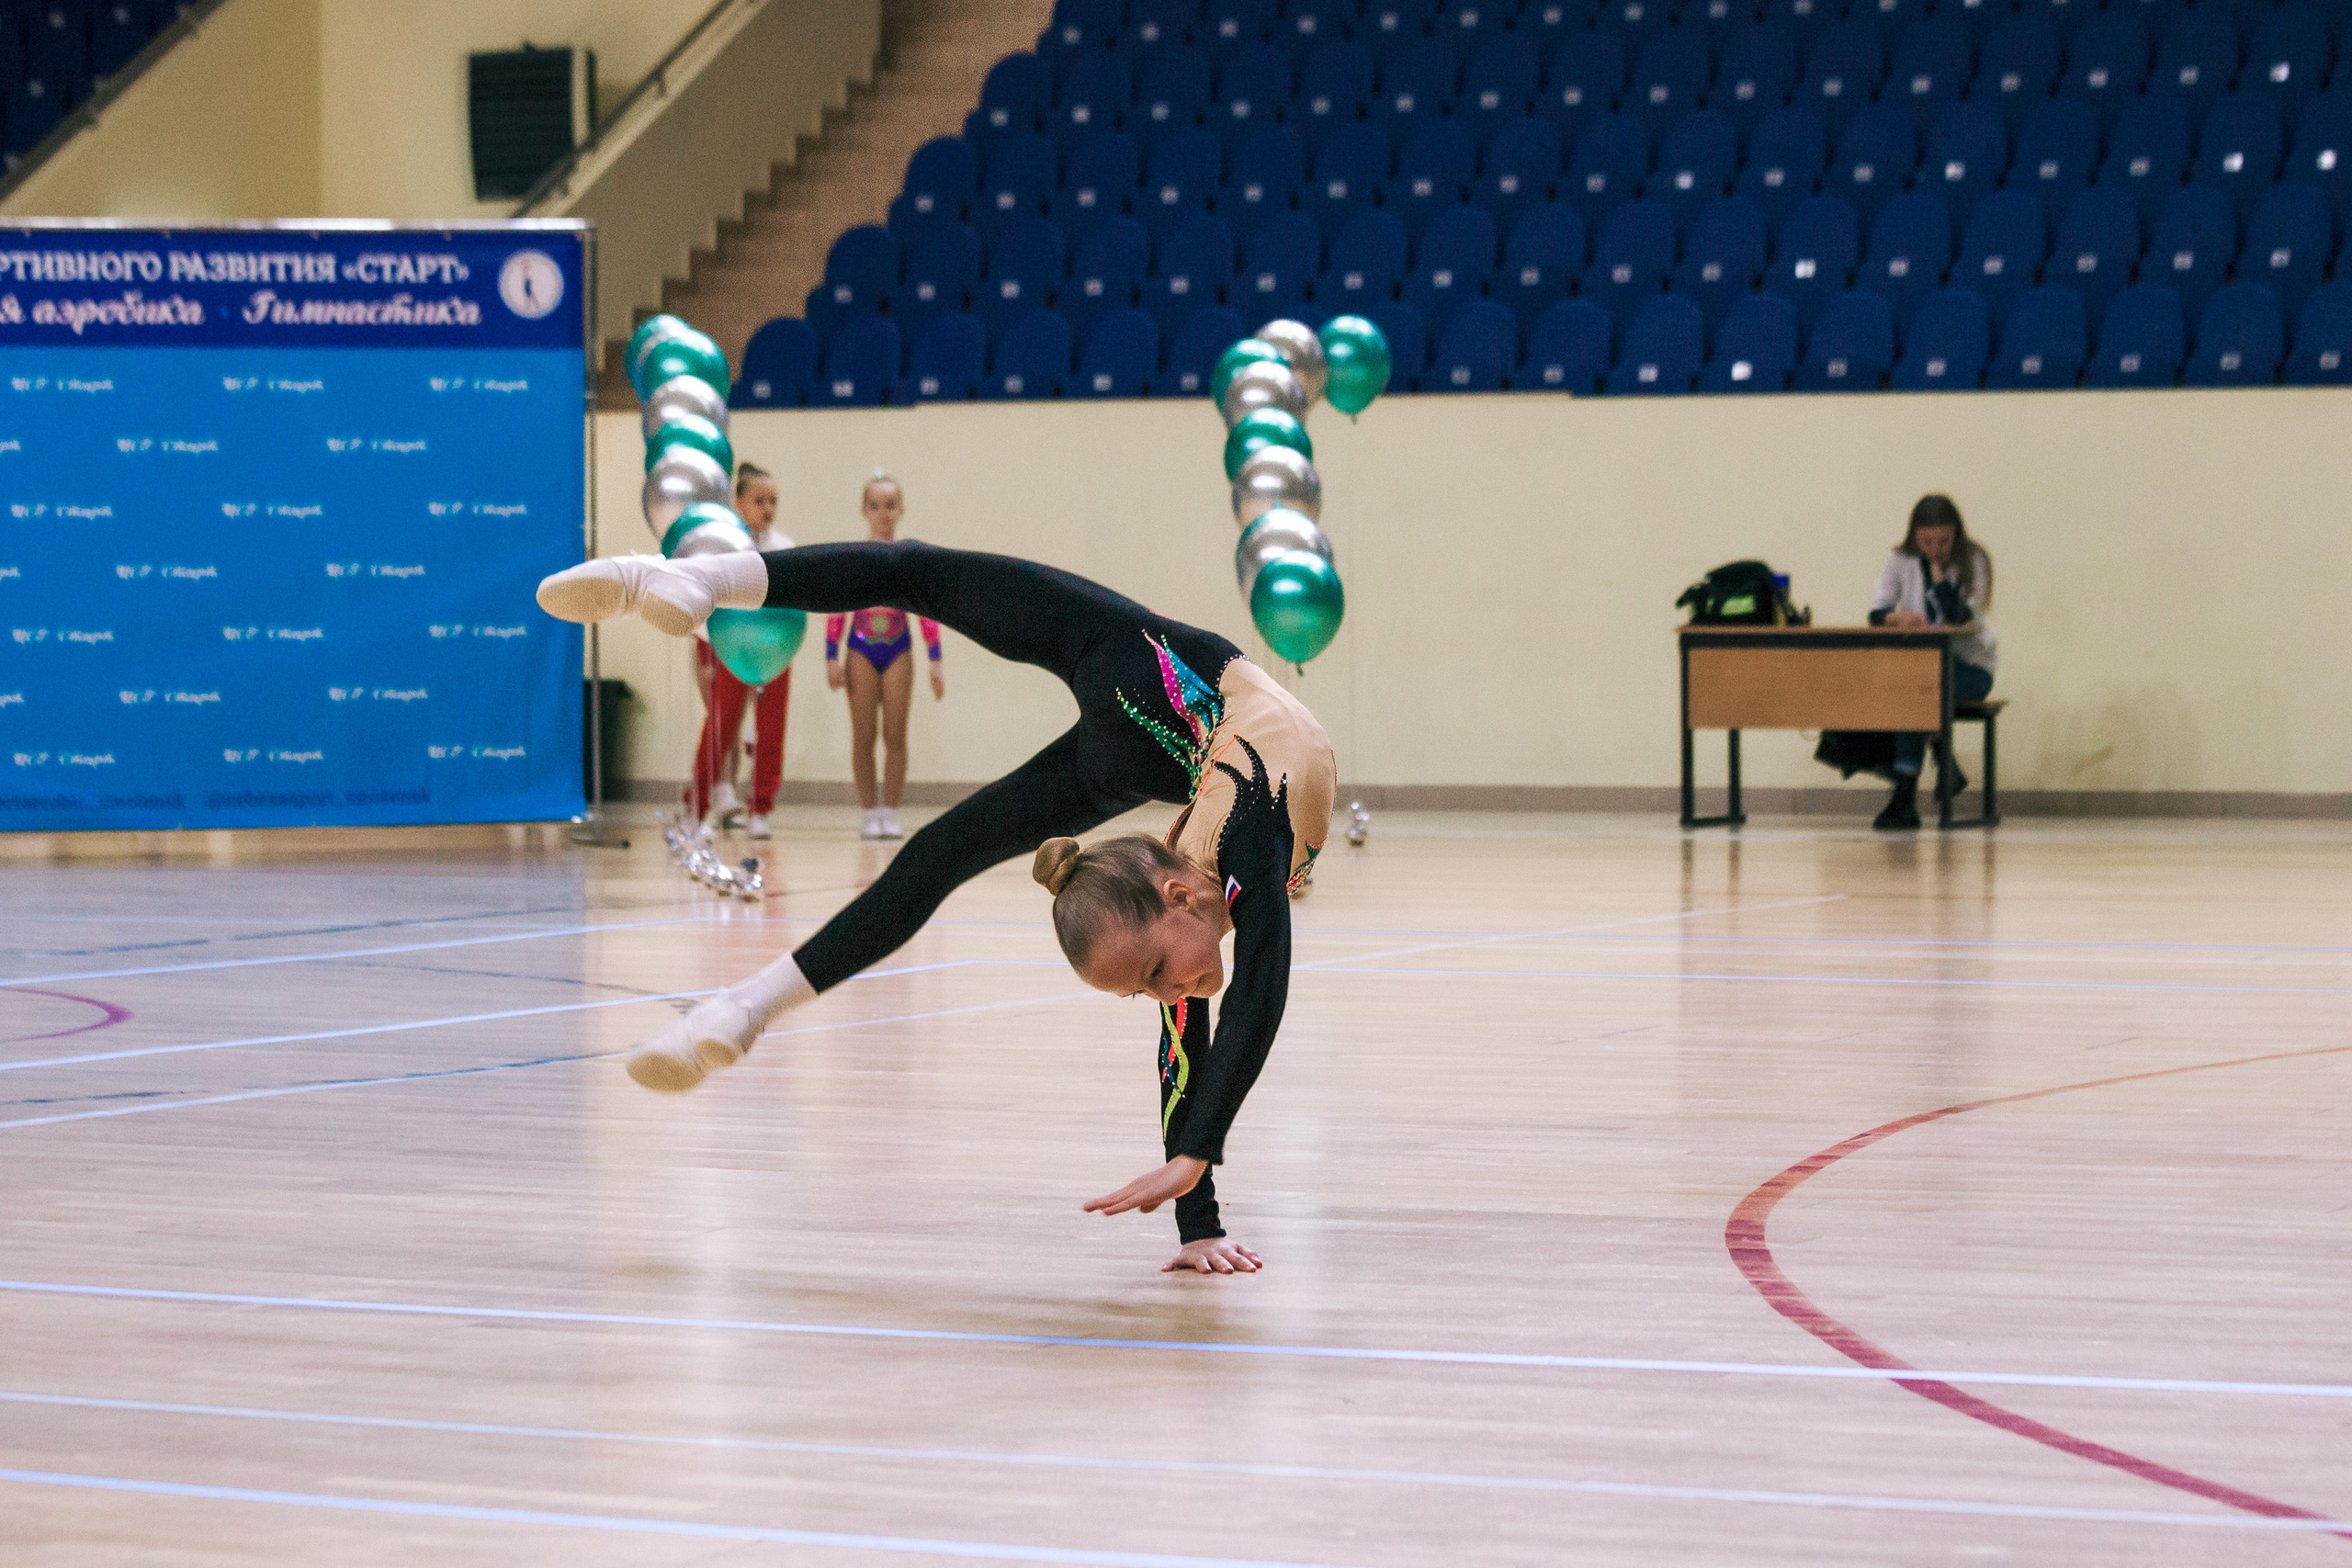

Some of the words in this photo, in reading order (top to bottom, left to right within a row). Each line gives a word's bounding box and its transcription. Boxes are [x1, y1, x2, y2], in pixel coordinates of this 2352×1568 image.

[167, 251, 337, 282] РАЗВИТИЯ
[343, 253, 469, 283] «СТАРТ»
[32, 289, 204, 335] аэробика
[242, 289, 482, 325] Гимнастика
